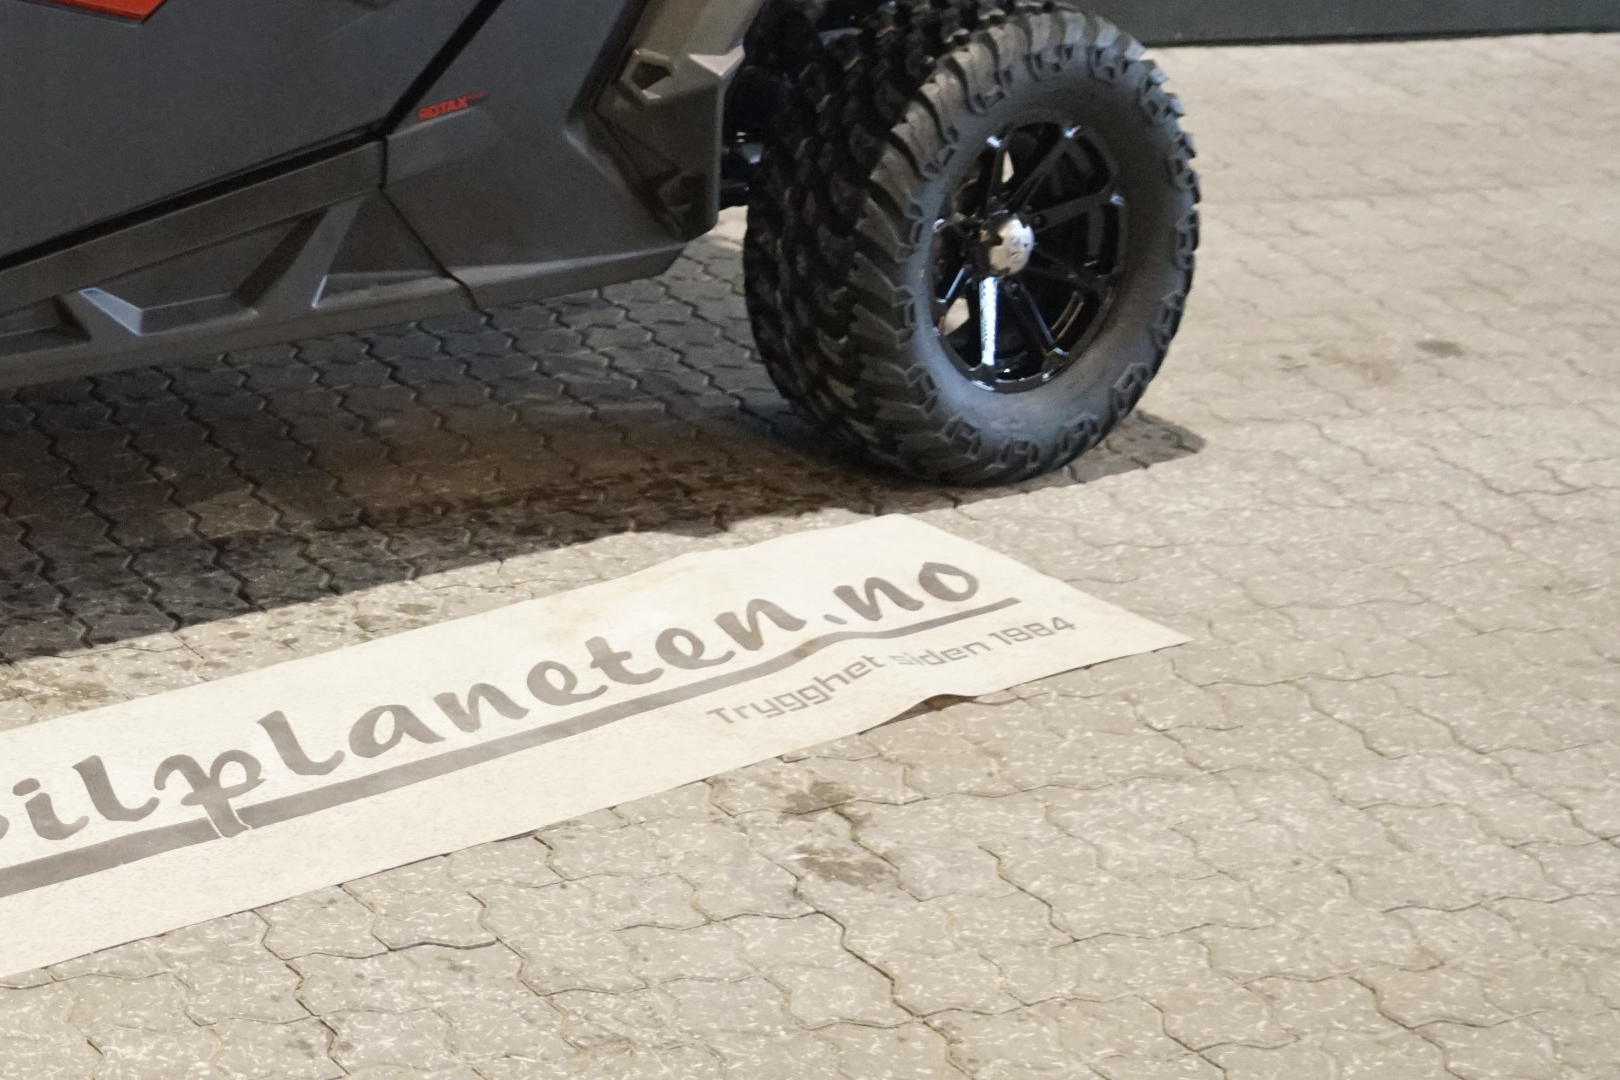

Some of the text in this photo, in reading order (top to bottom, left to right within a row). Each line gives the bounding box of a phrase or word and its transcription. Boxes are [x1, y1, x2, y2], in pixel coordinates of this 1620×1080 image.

[417, 96, 469, 121] ROTAX
[706, 615, 1076, 724] Trygghet siden 1984
